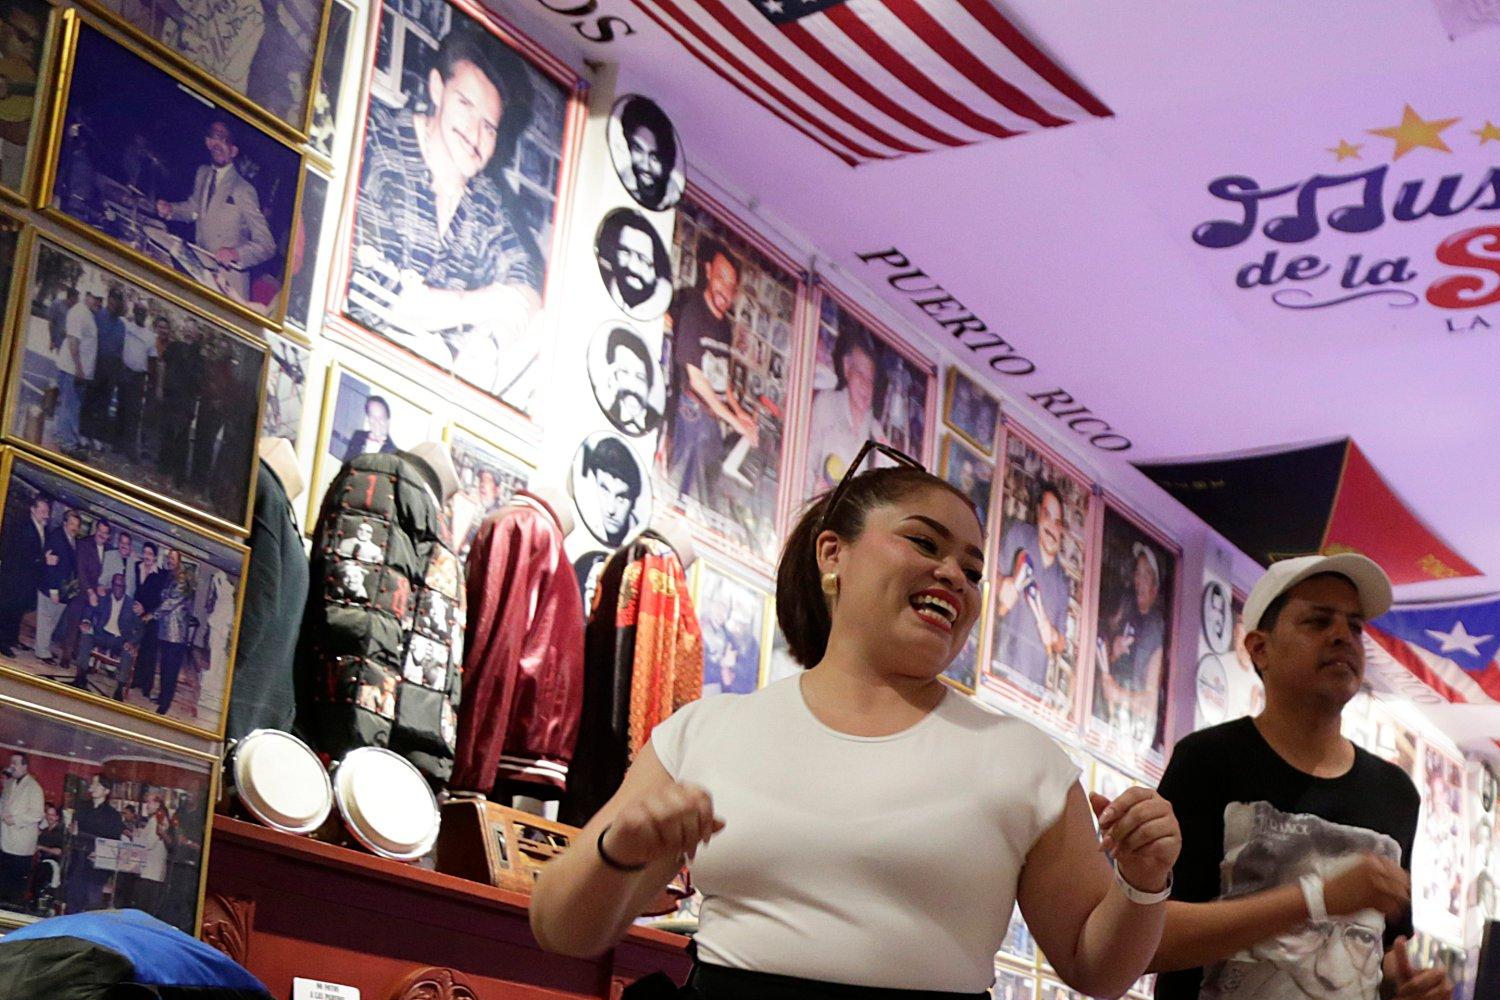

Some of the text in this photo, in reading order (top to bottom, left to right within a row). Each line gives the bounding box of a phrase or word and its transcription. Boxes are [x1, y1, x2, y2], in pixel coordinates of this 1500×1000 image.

[1236, 250, 1332, 289] de
[1340, 253, 1419, 290] la
[1444, 315, 1492, 334] LA
[854, 247, 1133, 453] PUERTO RICO
